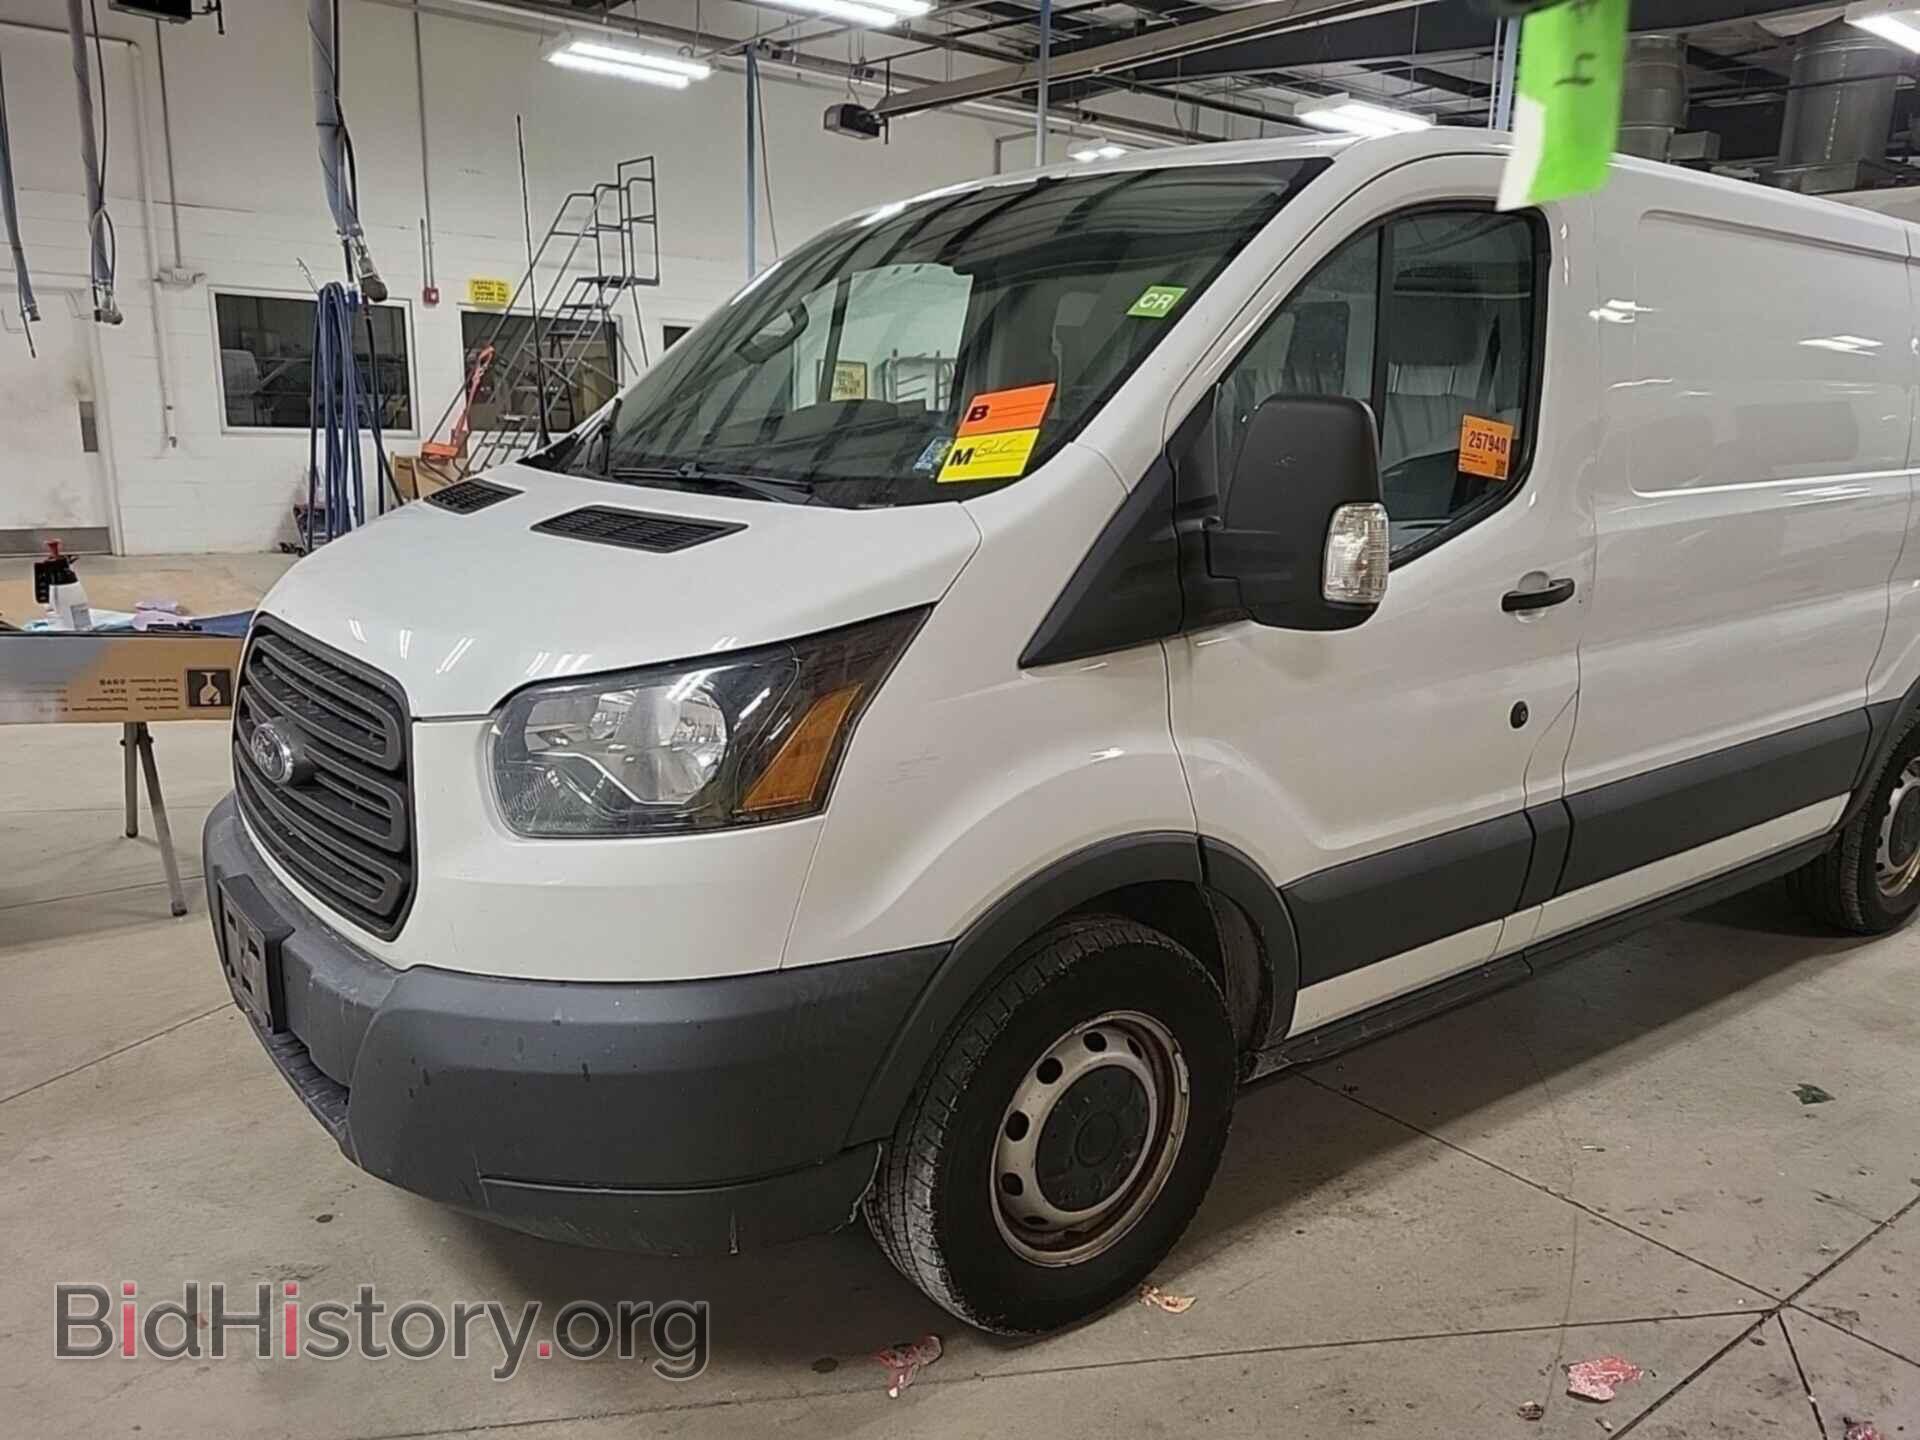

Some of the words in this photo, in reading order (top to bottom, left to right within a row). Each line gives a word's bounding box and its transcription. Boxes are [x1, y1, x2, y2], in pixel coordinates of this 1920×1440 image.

[1139, 293, 1174, 309] CR
[966, 405, 990, 423] B
[1468, 430, 1507, 455] 257940
[948, 447, 975, 466] M
